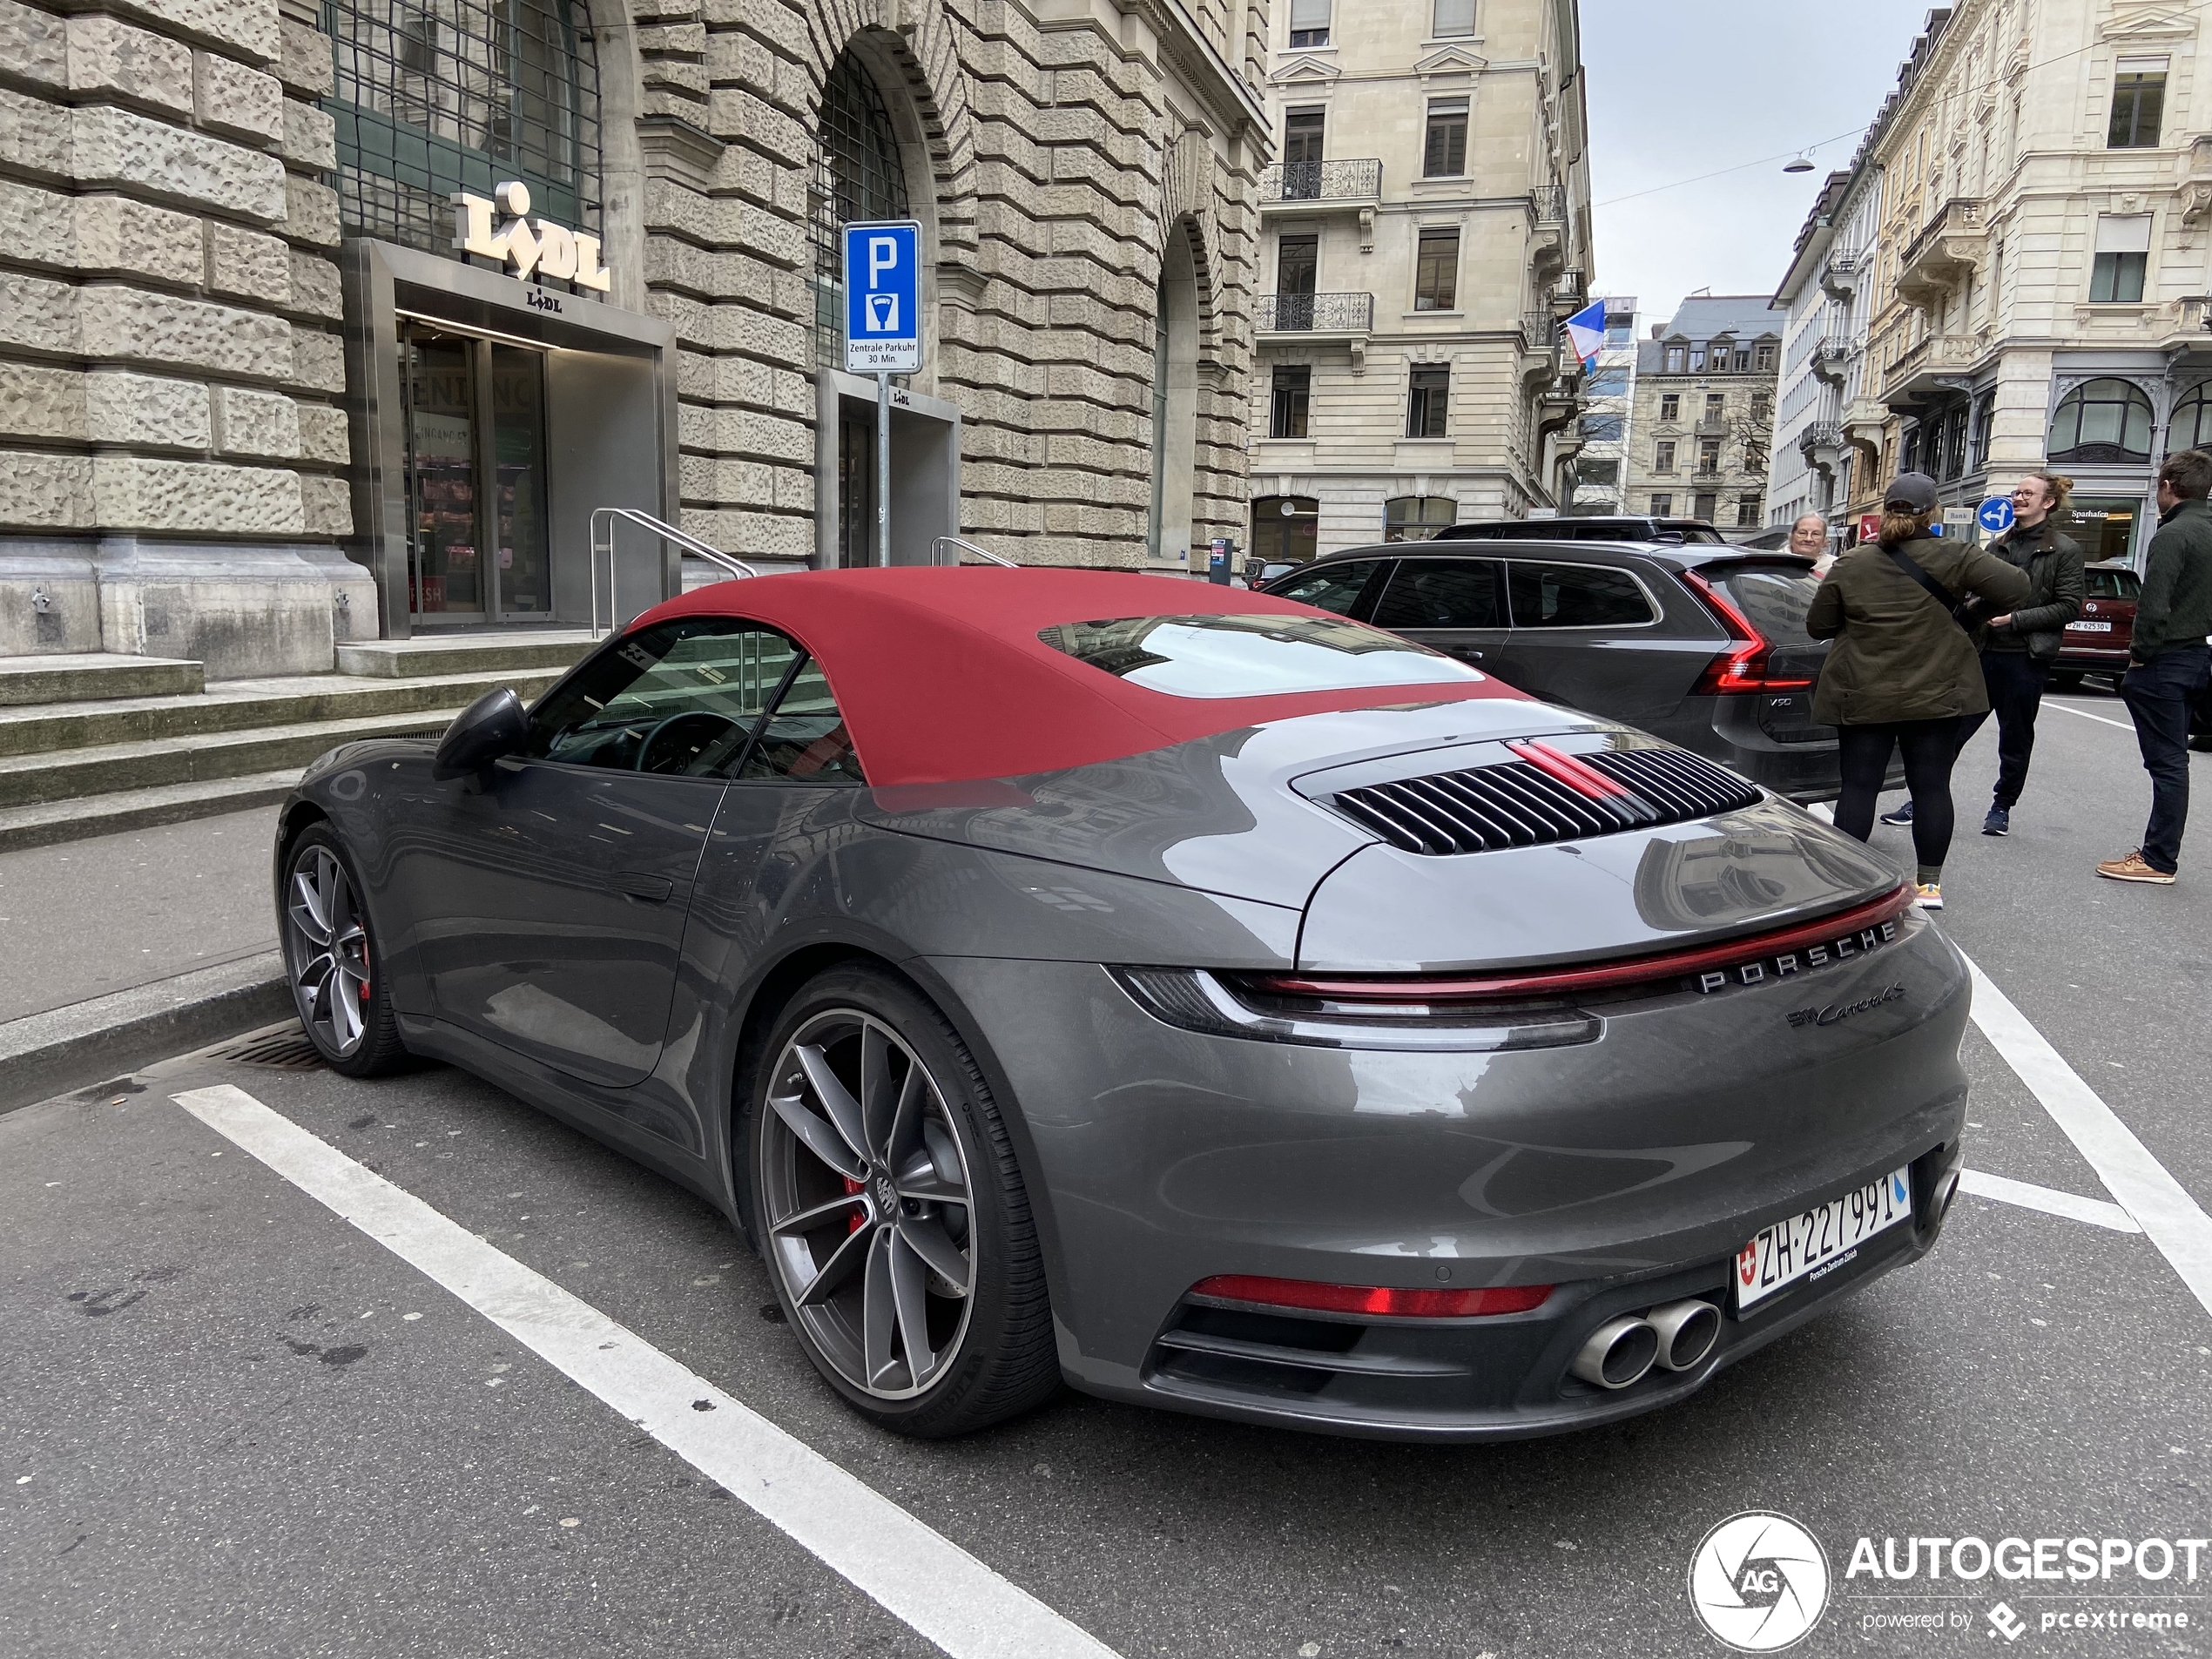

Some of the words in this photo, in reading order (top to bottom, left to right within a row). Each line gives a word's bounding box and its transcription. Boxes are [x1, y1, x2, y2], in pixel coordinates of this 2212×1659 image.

[869, 237, 898, 289] P
[850, 343, 883, 353] Zentrale
[886, 342, 916, 352] Parkuhr
[881, 354, 898, 363] Min.
[1770, 698, 1792, 707] V90
[1701, 921, 1896, 993] PORSCHE
[1785, 1006, 1818, 1028] 911
[1810, 1265, 1827, 1283] Porsche
[1827, 1258, 1844, 1271] Zentrum
[1844, 1249, 1858, 1264] Zürich
